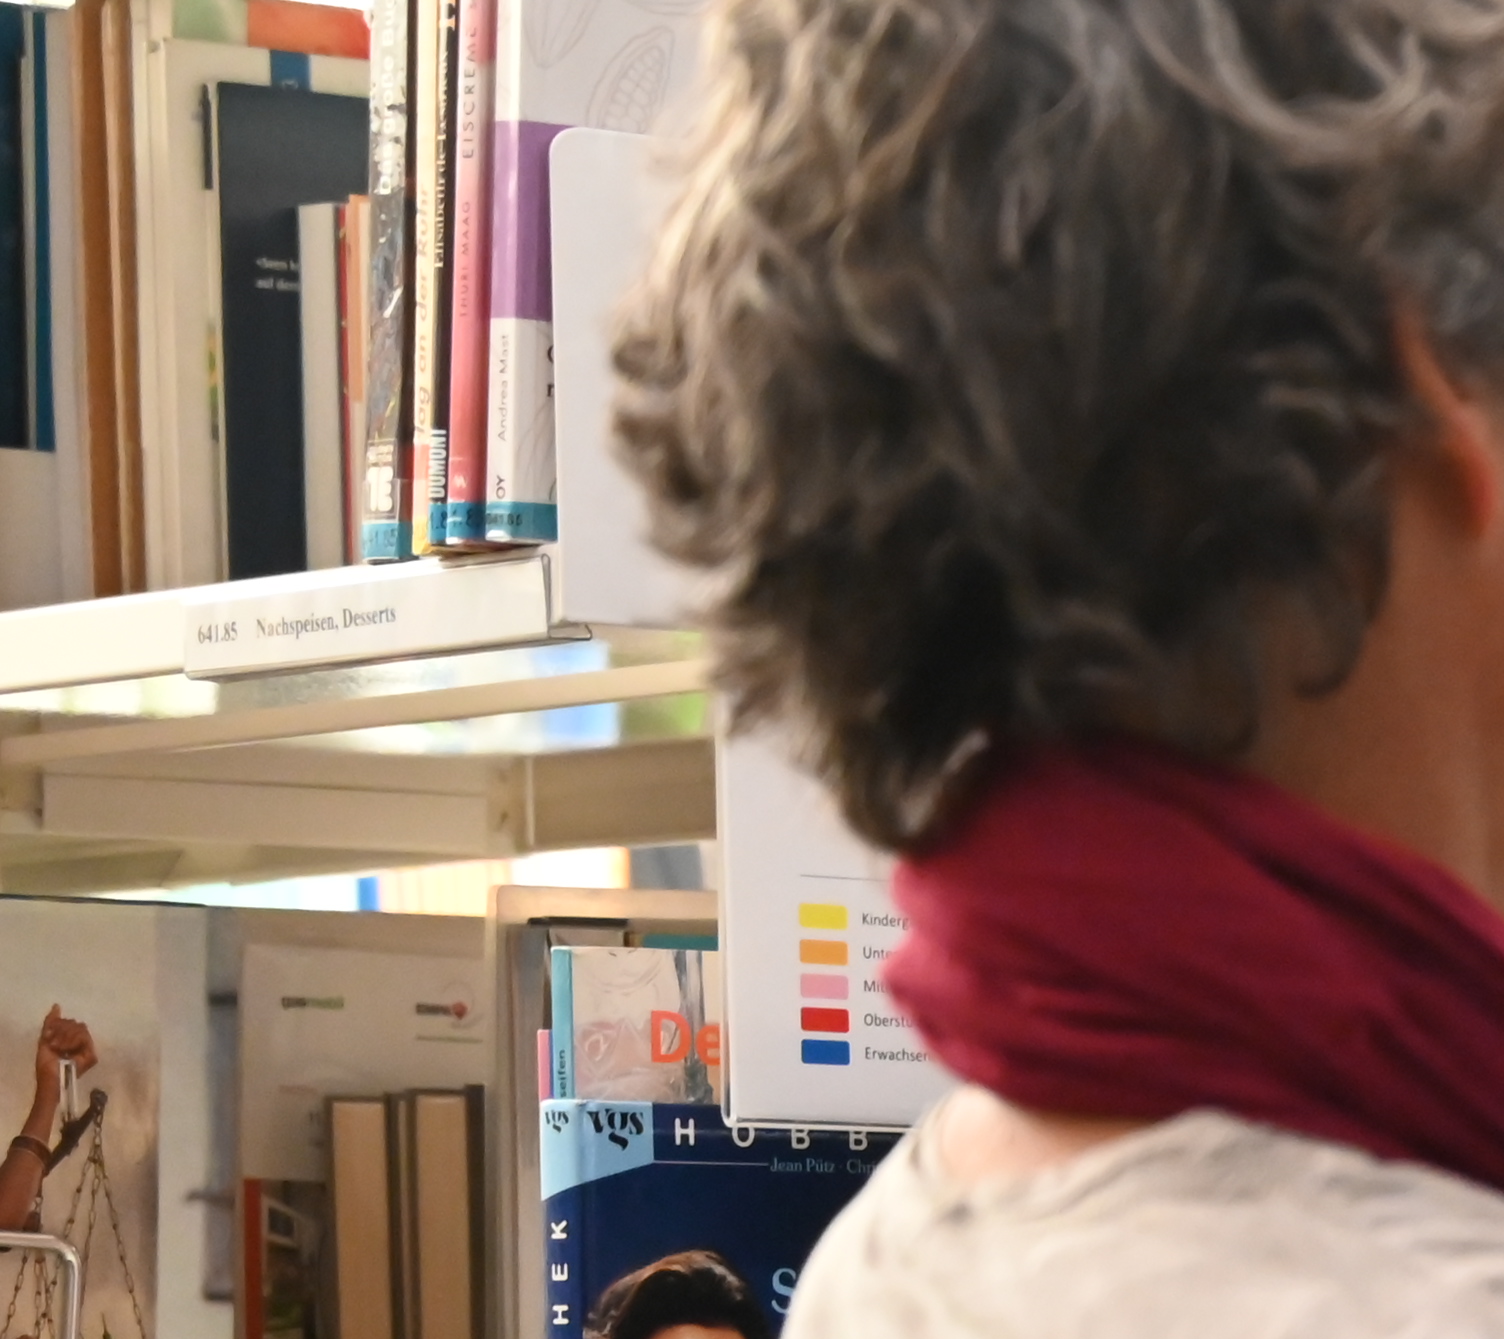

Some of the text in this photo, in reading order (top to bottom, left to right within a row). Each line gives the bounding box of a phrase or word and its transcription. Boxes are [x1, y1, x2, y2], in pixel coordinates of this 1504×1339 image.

[462, 201, 472, 256] MAAG
[419, 334, 429, 373] an
[497, 334, 510, 442] Andrea Mast
[197, 607, 397, 645] 641.85 Nachspeisen, Desserts
[545, 1110, 570, 1133] vgs
[587, 1108, 644, 1151] vgs
[770, 1157, 803, 1172] Jean
[805, 1157, 835, 1173] Pütz
